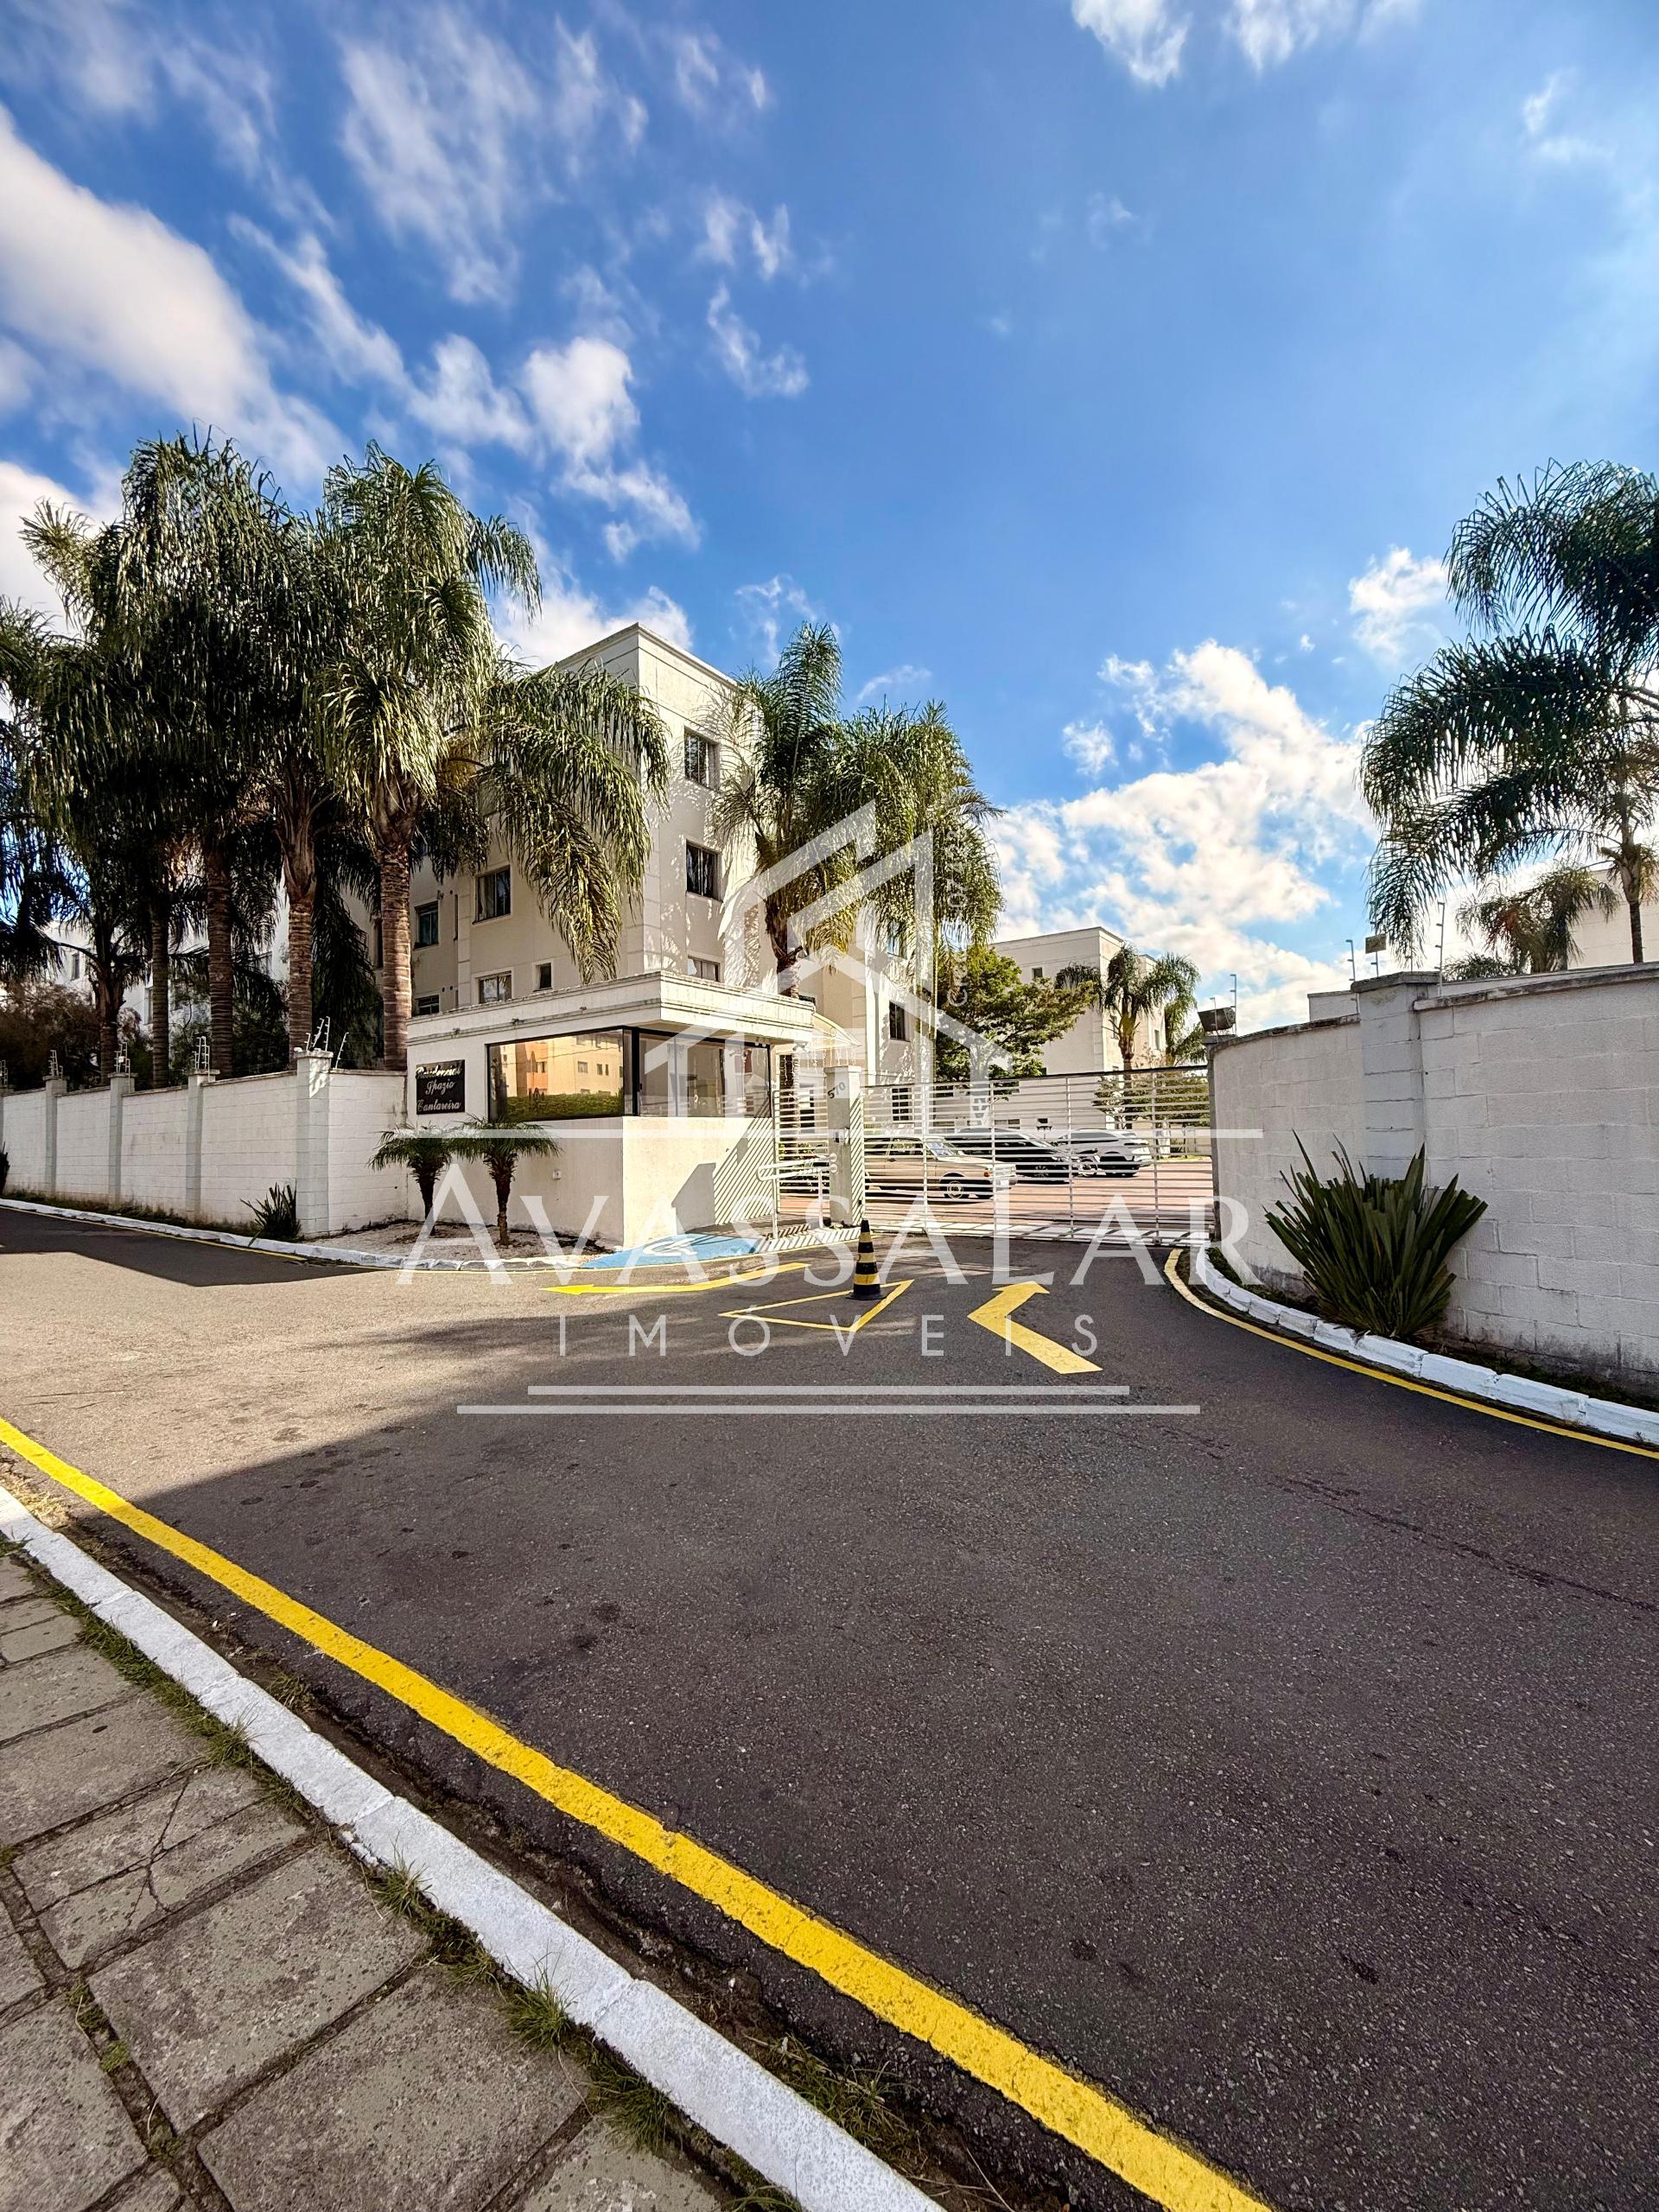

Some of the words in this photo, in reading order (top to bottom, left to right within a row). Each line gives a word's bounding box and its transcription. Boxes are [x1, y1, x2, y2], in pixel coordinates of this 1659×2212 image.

[425, 1079, 456, 1096] Spazio
[827, 1082, 847, 1099] 570
[416, 1099, 462, 1112] Cantareira
